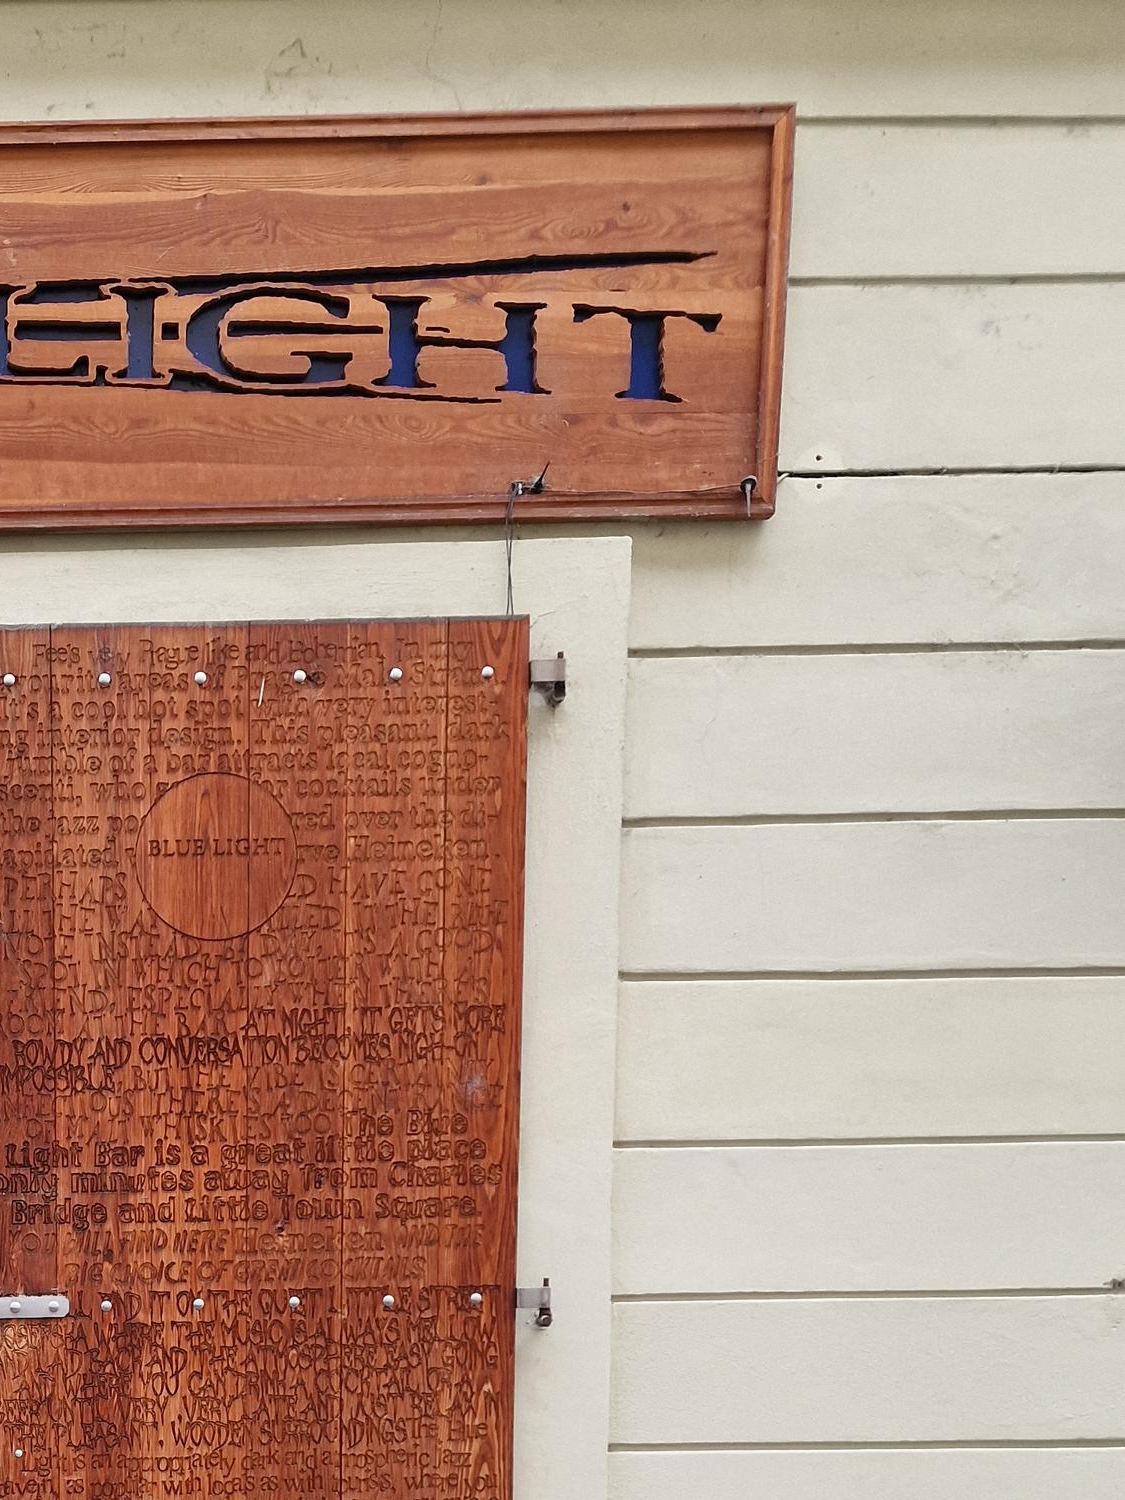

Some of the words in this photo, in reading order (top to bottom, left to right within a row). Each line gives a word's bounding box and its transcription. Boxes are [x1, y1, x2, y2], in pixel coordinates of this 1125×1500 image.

[148, 839, 205, 858] BLUE
[212, 837, 286, 858] LIGHT
[345, 1107, 394, 1138] The
[406, 1109, 469, 1137] Blue
[5, 1140, 84, 1176] Light
[93, 1141, 145, 1168] Bar
[154, 1138, 182, 1167] is
[190, 1144, 210, 1167] a
[220, 1136, 307, 1173] great
[70, 1165, 195, 1195] minutes
[203, 1166, 291, 1197] away
[299, 1162, 379, 1191] from
[387, 1160, 505, 1189] Charles
[10, 1196, 108, 1233] Bridge
[118, 1195, 176, 1224] and
[184, 1194, 270, 1223] Little
[275, 1193, 366, 1221] Town
